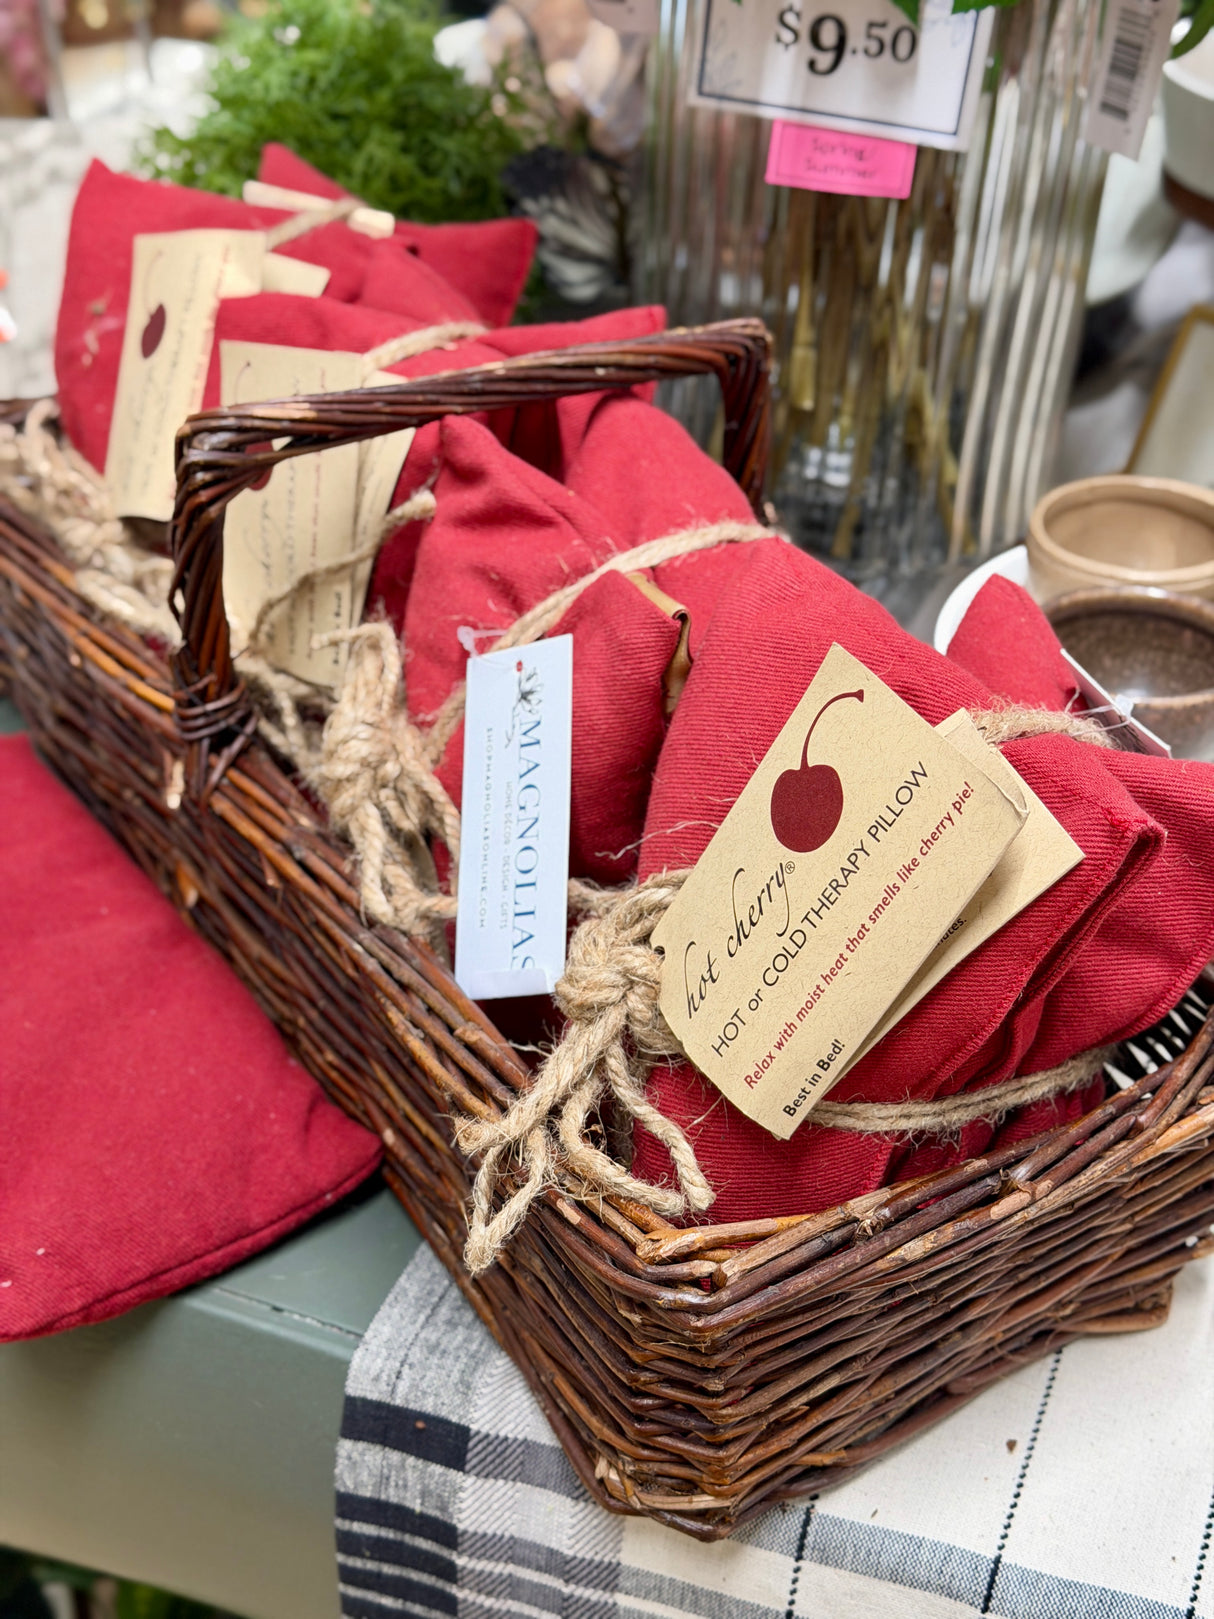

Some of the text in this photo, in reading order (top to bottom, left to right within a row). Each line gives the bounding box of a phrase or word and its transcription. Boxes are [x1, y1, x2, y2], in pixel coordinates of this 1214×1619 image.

[776, 5, 917, 76] $9.50
[712, 761, 928, 1057] HOT or COLD THERAPY PILLOW
[744, 781, 975, 1090] Relax with moist heat that smells like cherry pie!
[684, 941, 720, 1019] hot
[783, 1038, 845, 1118] Best in Bed!
